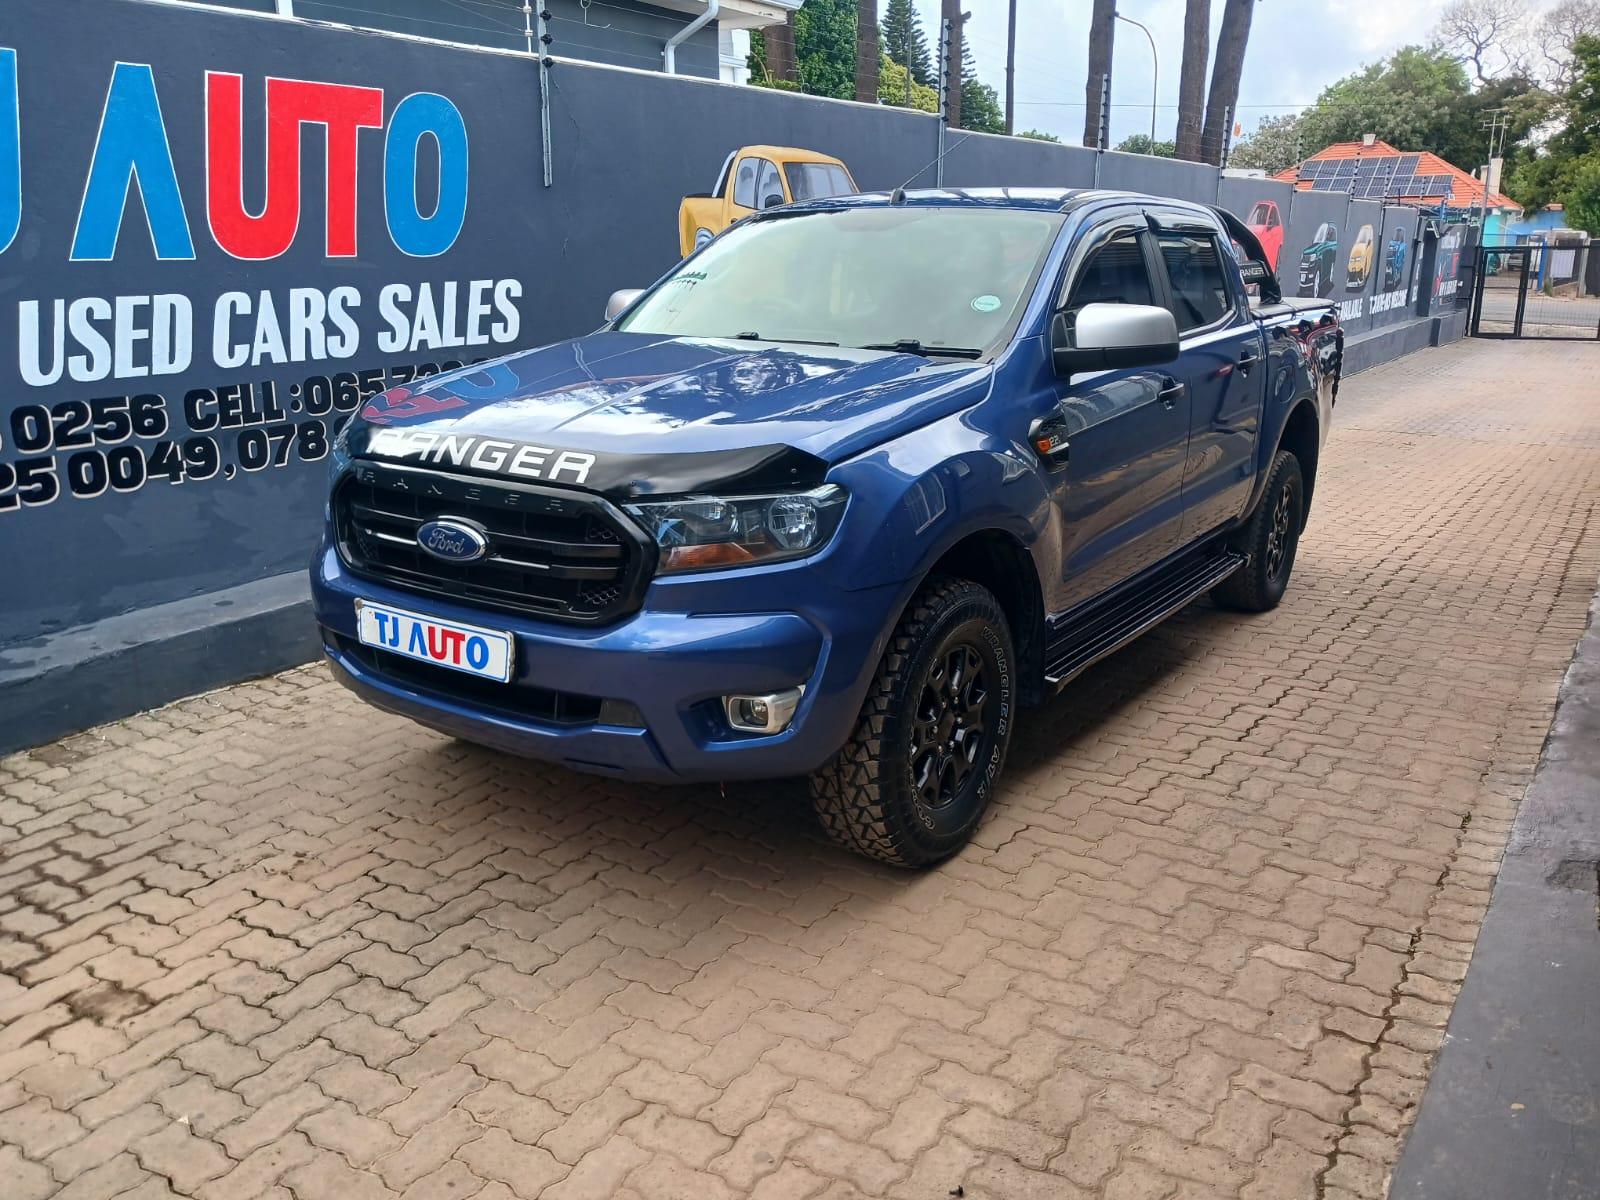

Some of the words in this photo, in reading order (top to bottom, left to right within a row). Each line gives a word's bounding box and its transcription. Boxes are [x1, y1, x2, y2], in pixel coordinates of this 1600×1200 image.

[68, 60, 470, 261] AUTO
[18, 293, 193, 387] USED
[212, 285, 361, 370] CARS
[377, 278, 523, 354] SALES
[9, 393, 170, 454] 0256
[365, 428, 596, 484] RANGER
[427, 527, 465, 555] Ford
[374, 612, 400, 648] TJ
[408, 622, 489, 670] AUTO
[982, 625, 1009, 736] WRANGLER
